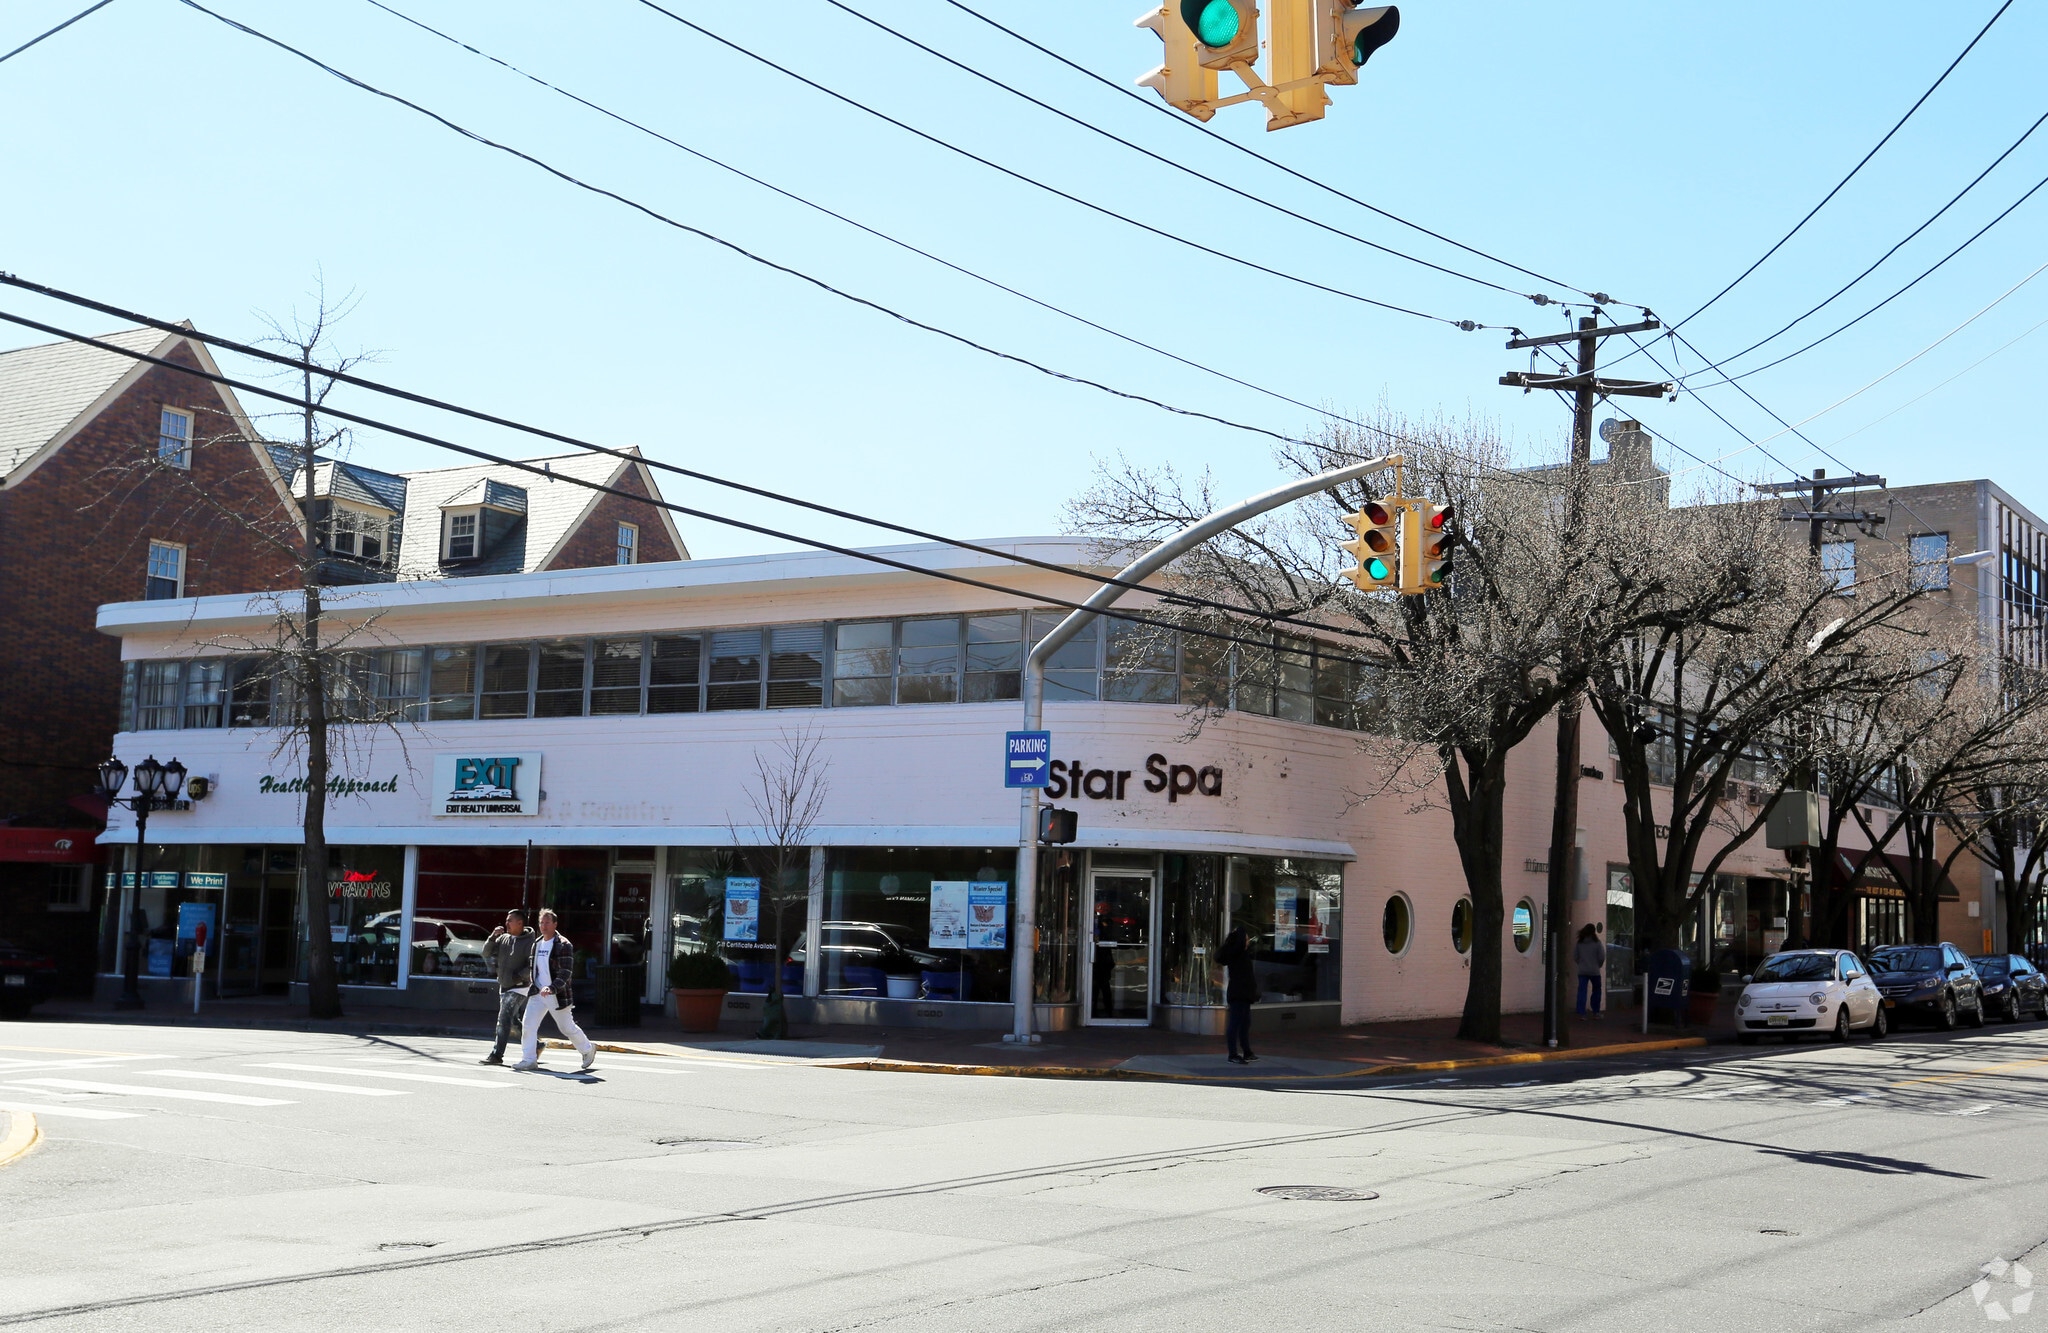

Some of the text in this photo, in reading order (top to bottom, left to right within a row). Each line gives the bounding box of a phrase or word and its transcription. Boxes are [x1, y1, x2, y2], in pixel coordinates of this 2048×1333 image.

[1009, 738, 1047, 753] PARKING
[1043, 752, 1223, 803] Star Spa
[325, 774, 398, 798] Approach
[446, 804, 522, 813] EXIT REALTY UNIVERSAL
[190, 875, 223, 886] We Print
[328, 882, 391, 898] VITAMINS
[987, 885, 1003, 894] Special
[726, 941, 753, 949] Certificate
